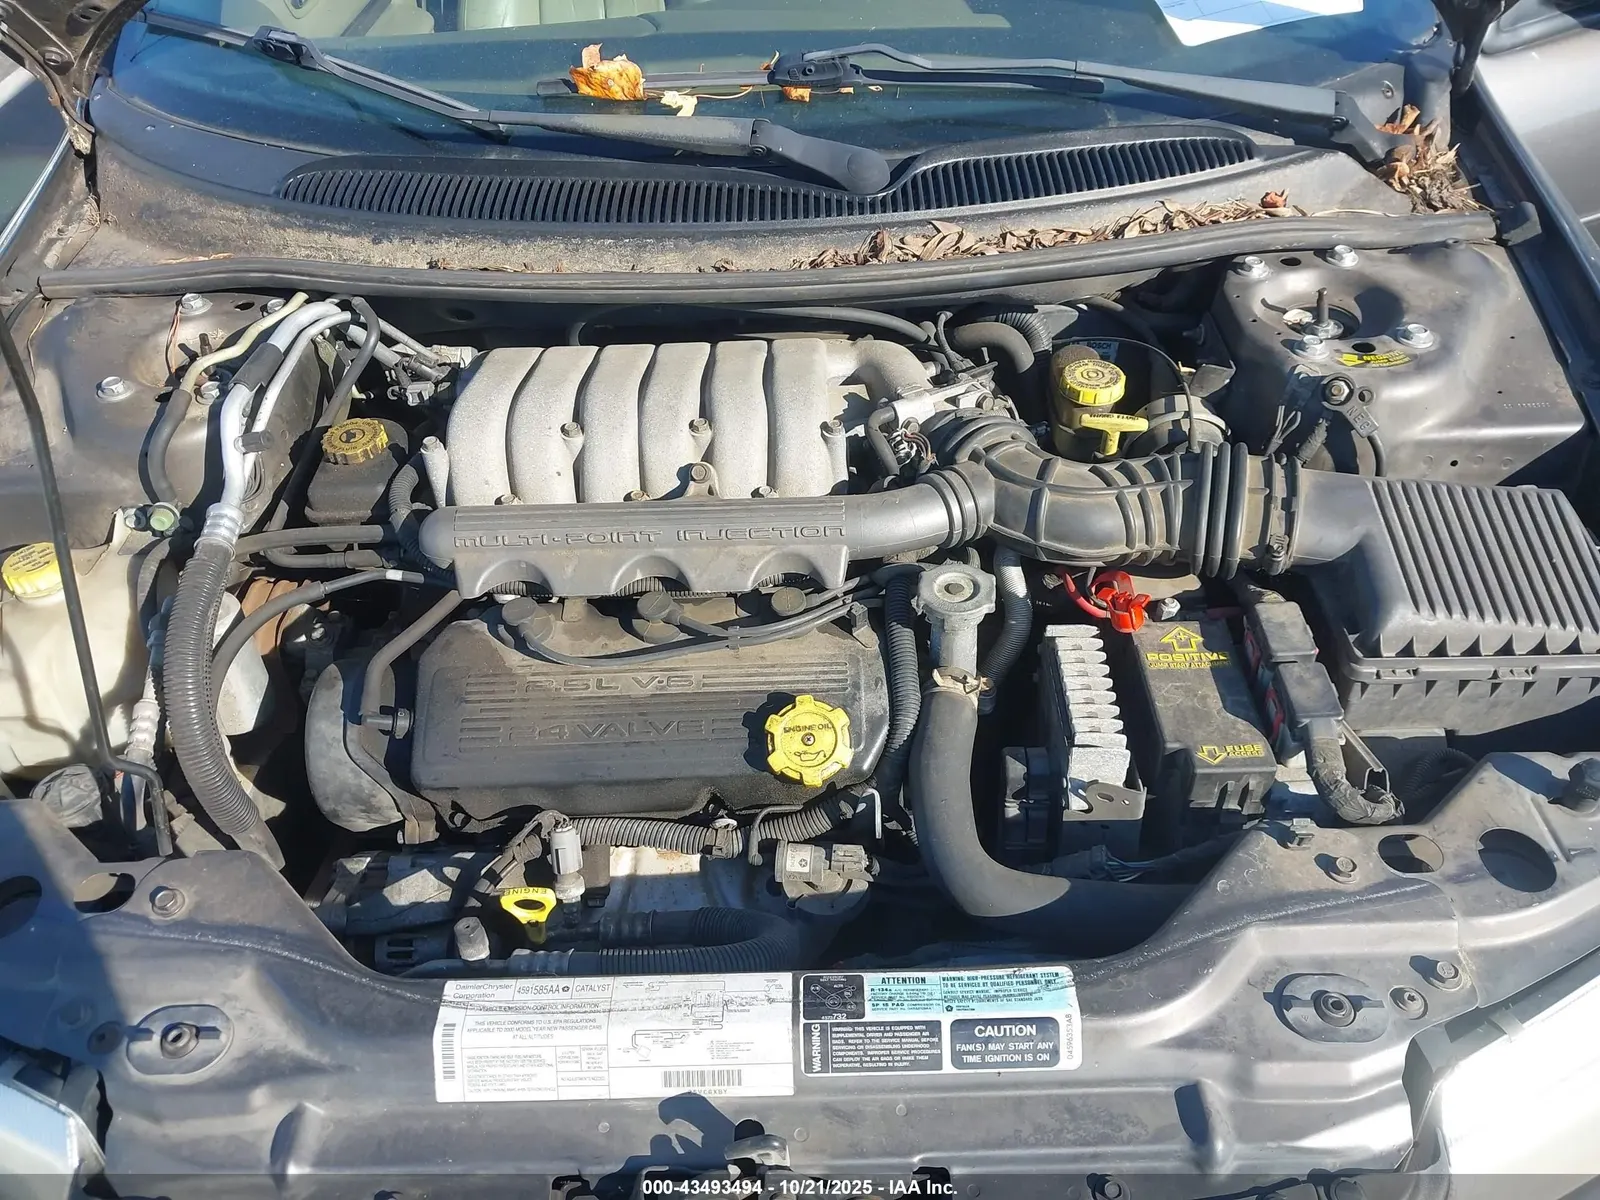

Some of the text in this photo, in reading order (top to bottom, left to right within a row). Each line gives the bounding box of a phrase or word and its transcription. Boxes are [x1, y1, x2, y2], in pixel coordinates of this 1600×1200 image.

[1346, 406, 1372, 430] NEG
[676, 525, 846, 540] INJECTION
[1146, 652, 1228, 661] POSITIVE
[526, 676, 620, 692] 2.5L
[508, 719, 704, 741] 24 VALVE
[783, 724, 817, 733] ENGINE
[1225, 744, 1263, 752] FUSE
[504, 888, 547, 896] ENGINE
[455, 983, 513, 991] DaimlerChrysler
[517, 984, 560, 995] 4591585AA
[575, 984, 611, 992] CATALYST
[974, 1024, 1037, 1037] CAUTION
[1065, 1013, 1073, 1060] 04596353AB
[812, 1024, 821, 1072] WARNING
[956, 1043, 985, 1052] FAN(S)
[1008, 1042, 1034, 1050] START
[1037, 1041, 1054, 1050] ANY
[985, 1054, 1022, 1062] IGNITION
[1037, 1053, 1050, 1061] ON
